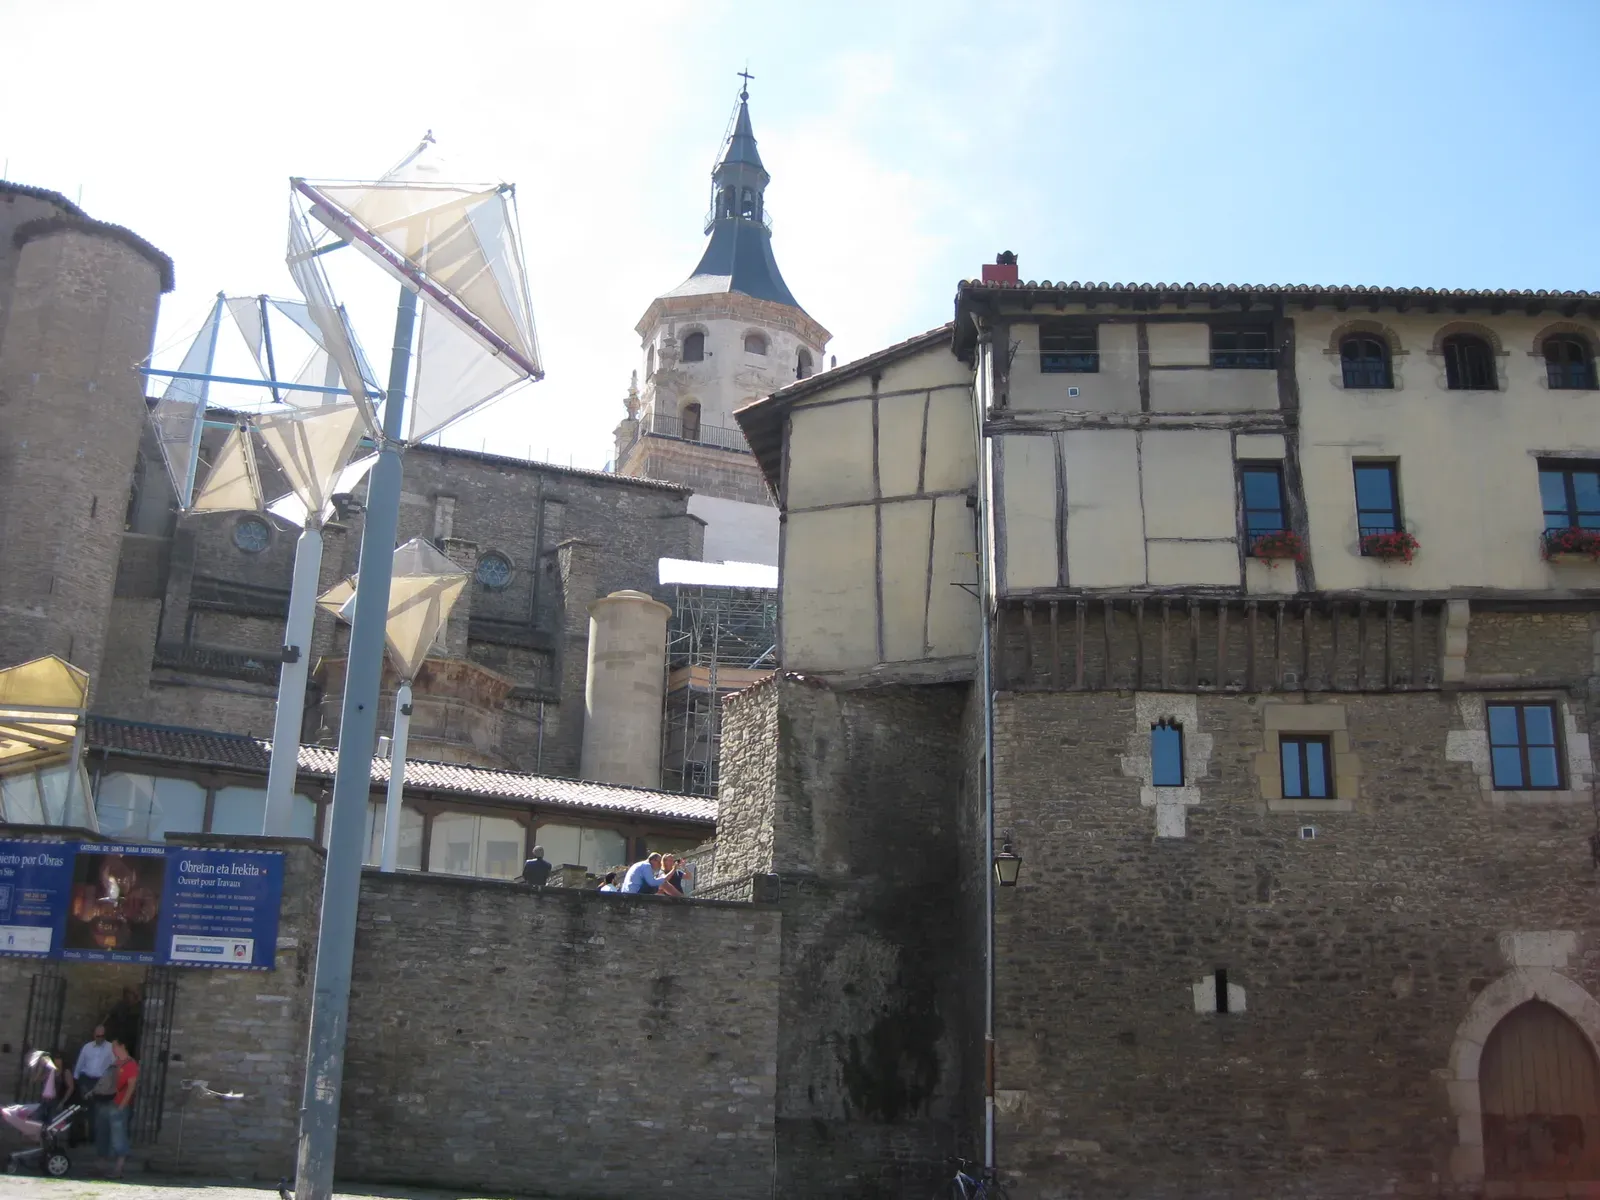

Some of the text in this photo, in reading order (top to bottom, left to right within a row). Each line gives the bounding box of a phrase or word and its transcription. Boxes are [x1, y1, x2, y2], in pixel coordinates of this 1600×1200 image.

[80, 844, 101, 852] CATEDRAL
[111, 845, 124, 853] SANTA
[0, 852, 64, 868] ierto por Obras
[179, 860, 260, 876] Obretan eta Irekita
[178, 876, 241, 888] Ouvert pour Travaux
